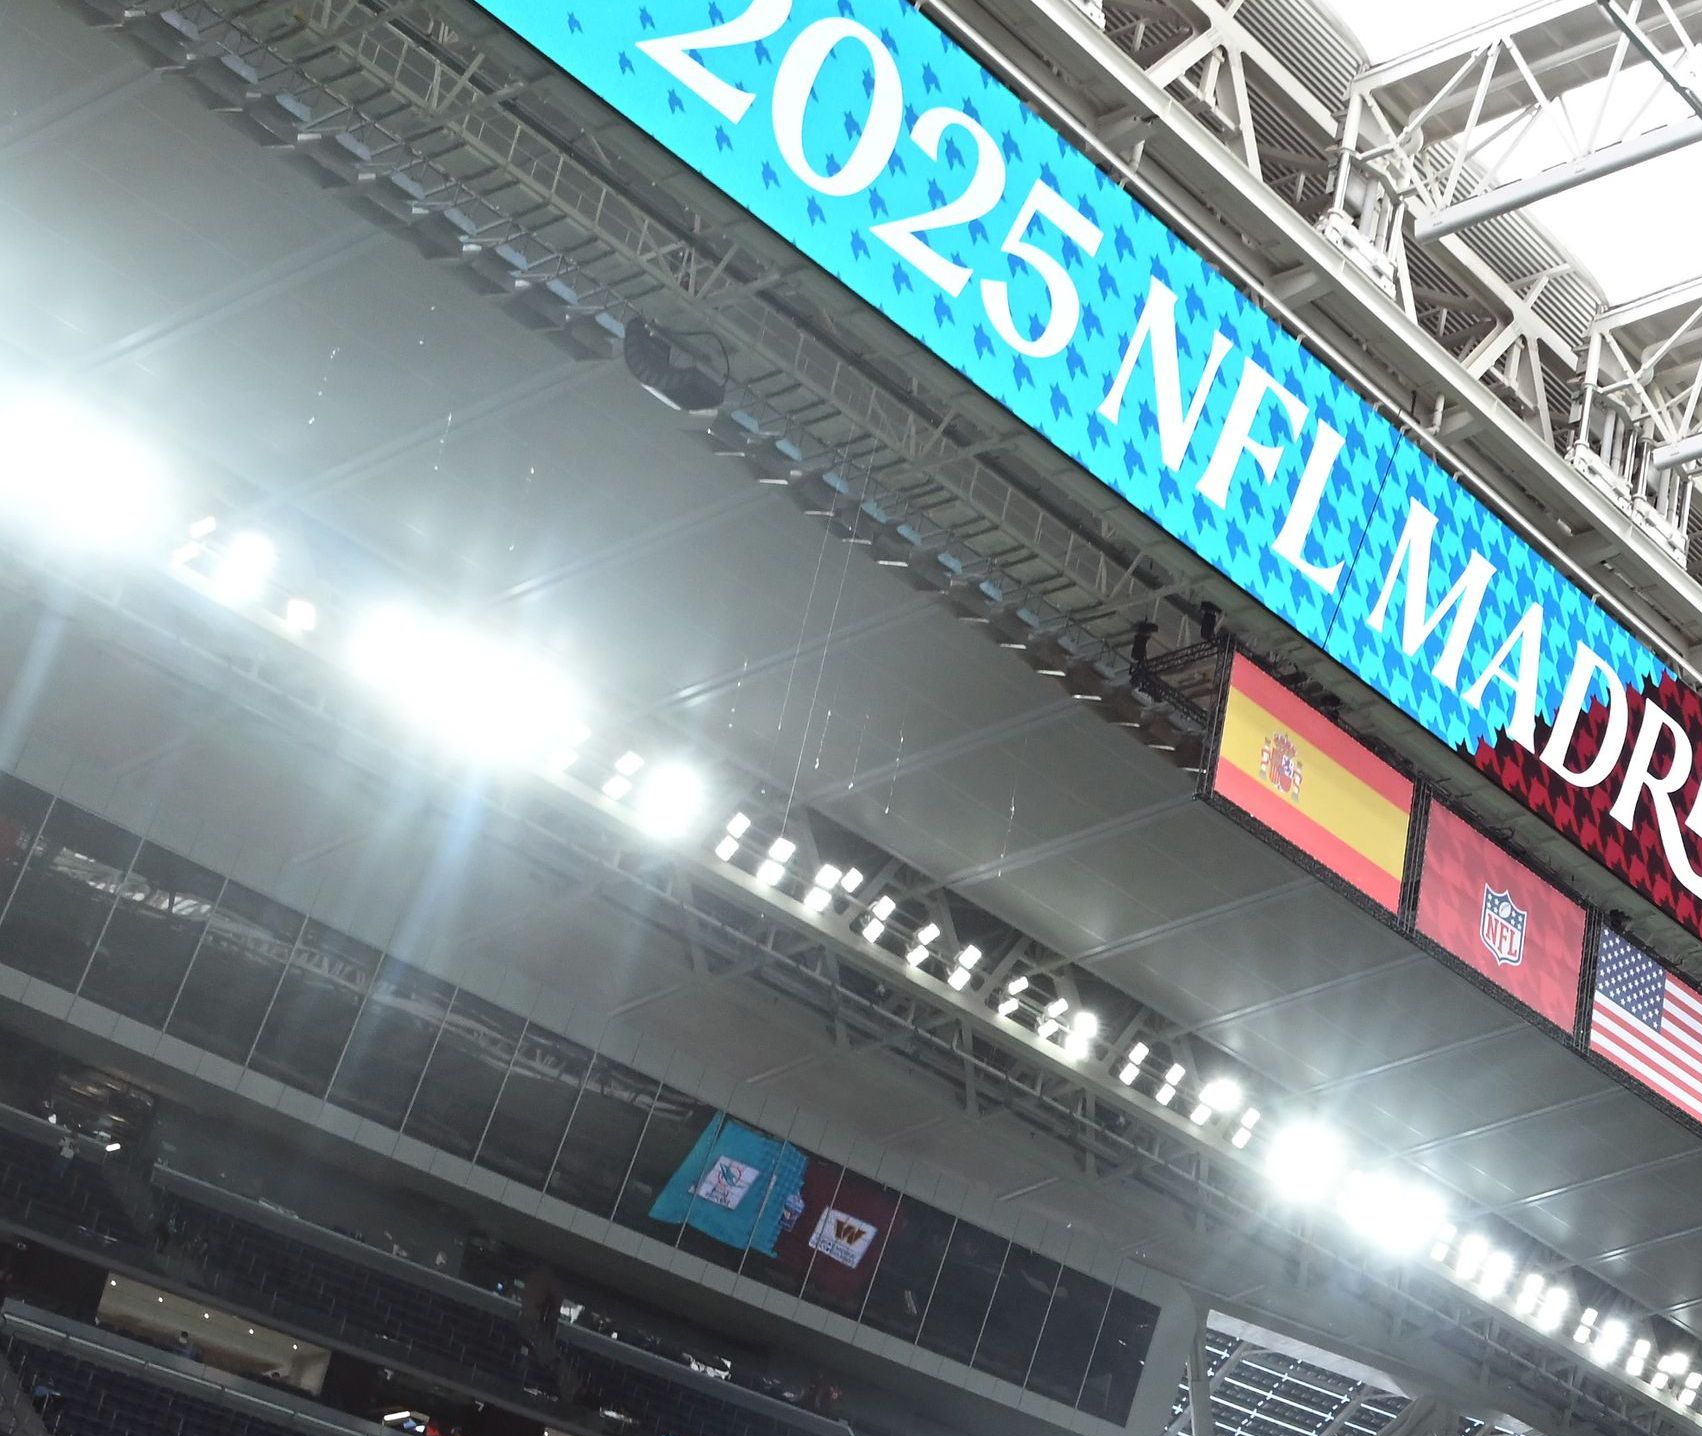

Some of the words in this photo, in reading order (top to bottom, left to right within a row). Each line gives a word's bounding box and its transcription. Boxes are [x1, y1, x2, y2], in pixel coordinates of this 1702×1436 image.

[636, 0, 1102, 358] 2025
[1100, 276, 1346, 592] NFL
[1486, 912, 1517, 957] NFL
